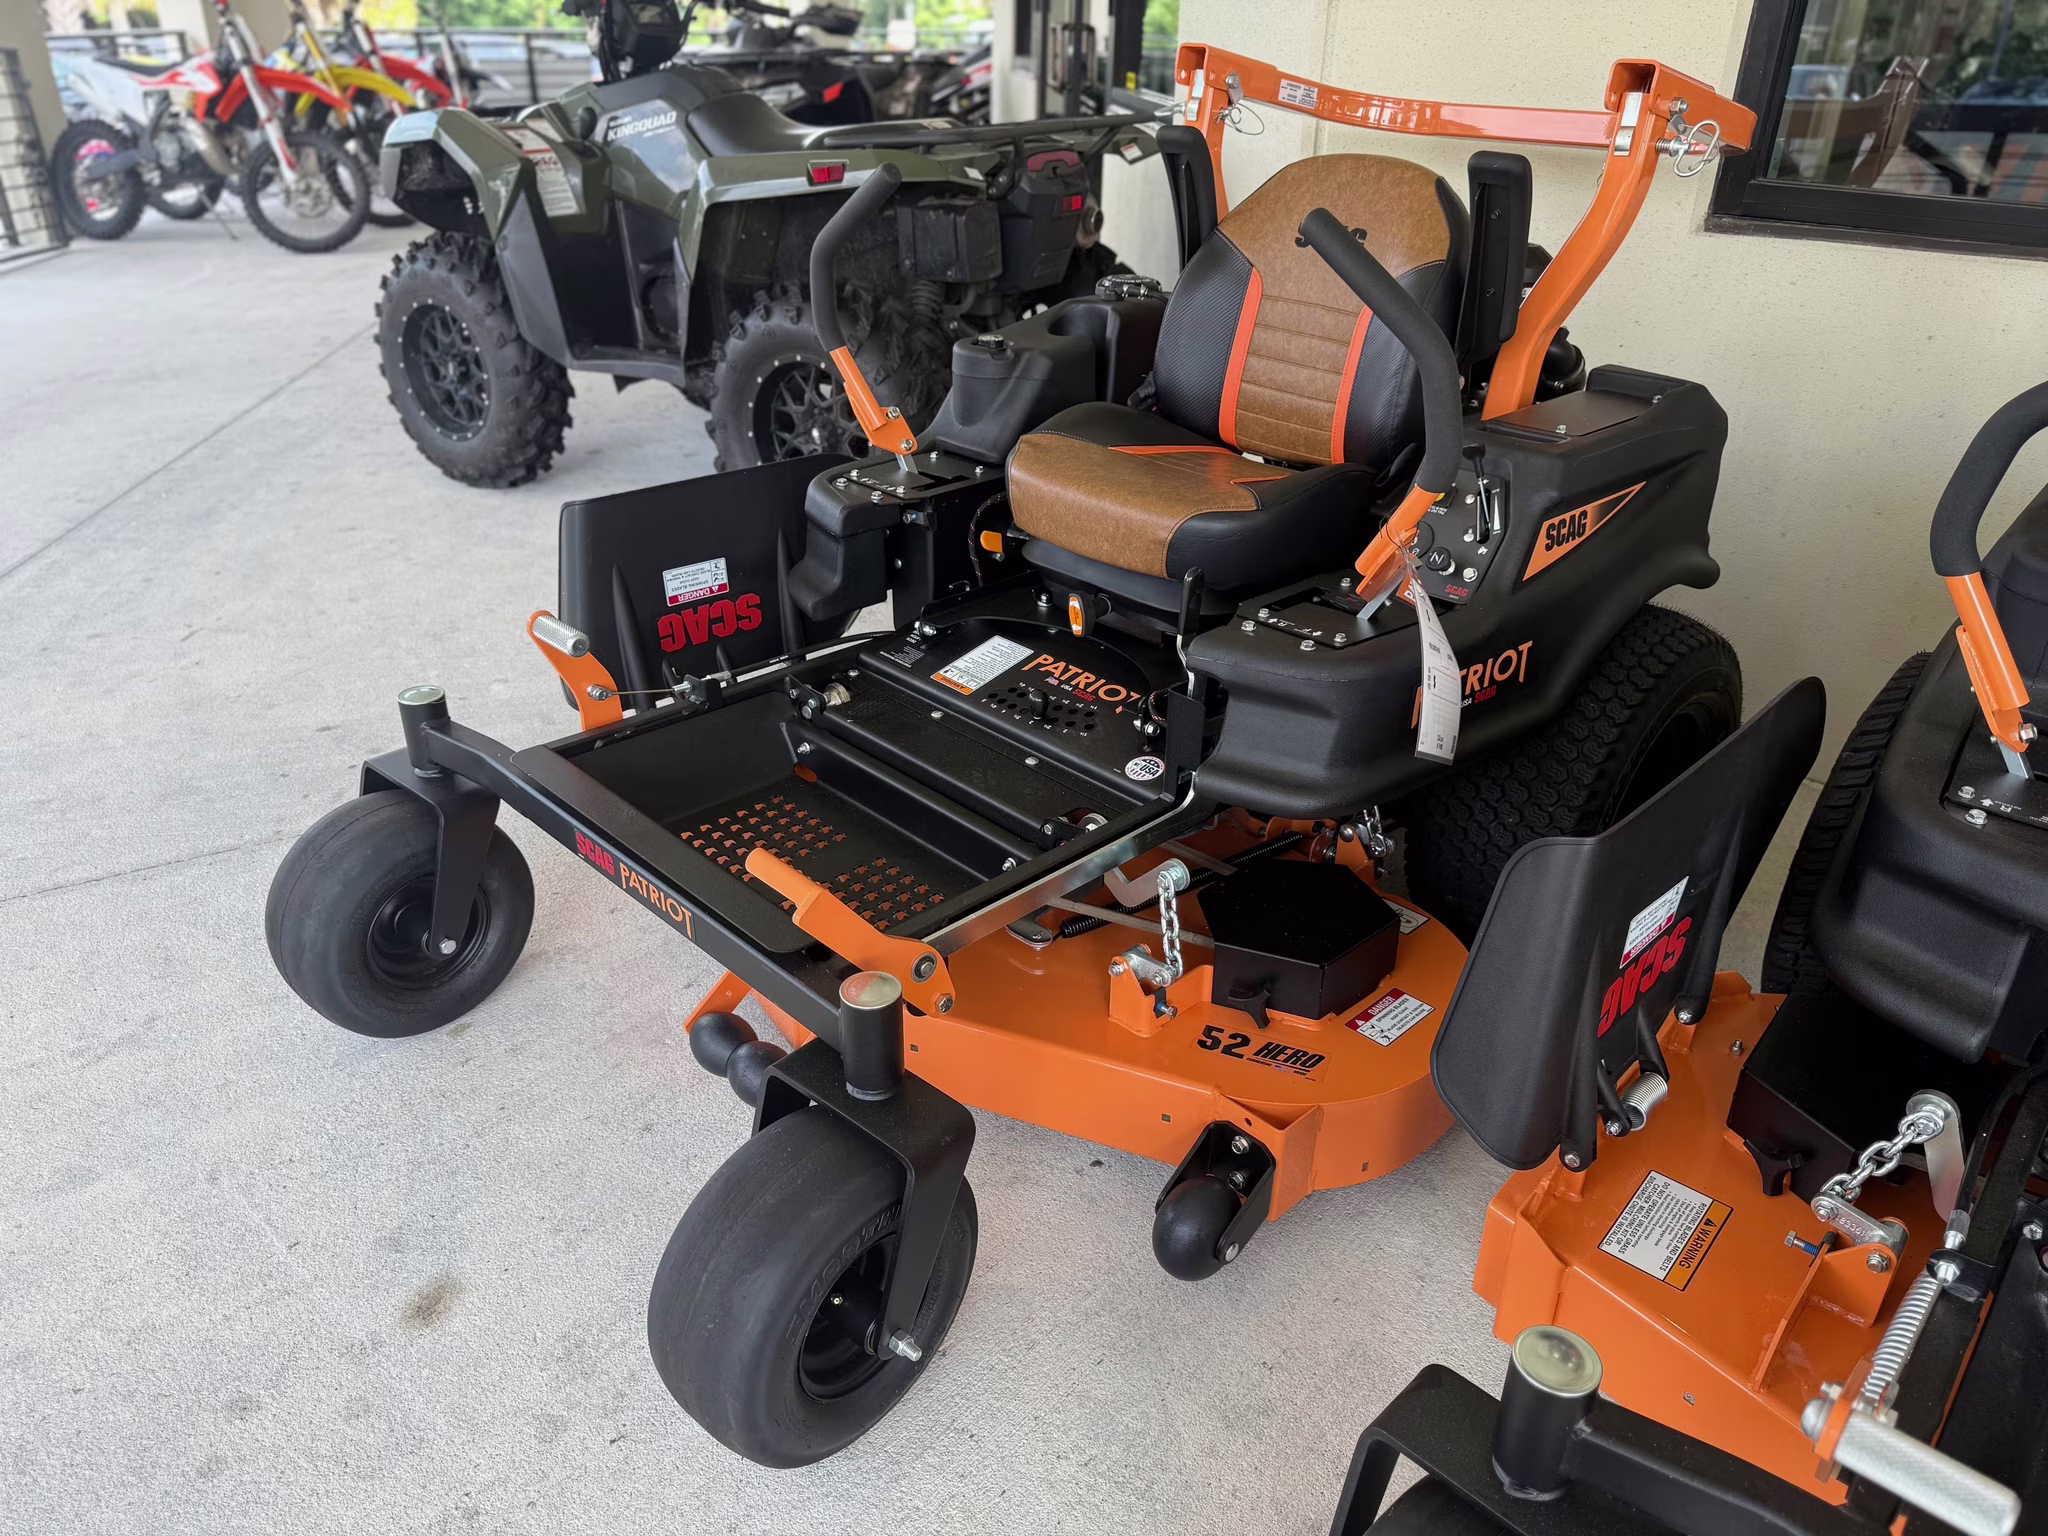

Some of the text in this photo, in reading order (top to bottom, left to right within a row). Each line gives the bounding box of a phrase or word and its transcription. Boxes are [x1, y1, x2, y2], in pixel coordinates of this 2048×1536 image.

[1544, 510, 1589, 552] SCAG
[677, 587, 709, 601] DANGER
[1445, 584, 1469, 597] SCAG
[657, 593, 762, 652] SCAG
[1021, 654, 1142, 711] PATRIOT
[1475, 685, 1497, 704] SCAG
[1140, 761, 1160, 777] USA
[575, 831, 692, 939] SCAG PATRIOT
[1597, 917, 1693, 1038] SCAG
[1367, 995, 1396, 1015] DANGER
[1374, 997, 1409, 1022] SPINNING BLADES
[1196, 1024, 1326, 1069] 52 HERO
[1624, 1200, 1639, 1216] CHUTE
[1635, 1175, 1656, 1201] DISCHARGE
[1603, 1220, 1625, 1246] INSTALLED
[1614, 1182, 1660, 1245] CATCHER, MULCHING KIT OR
[1617, 1181, 1670, 1254] DO NOT OPERATE UNLESS GRASS
[1658, 1202, 1707, 1272] ROTATING BLADES AND BELTS
[1677, 1226, 1711, 1270] WARNING
